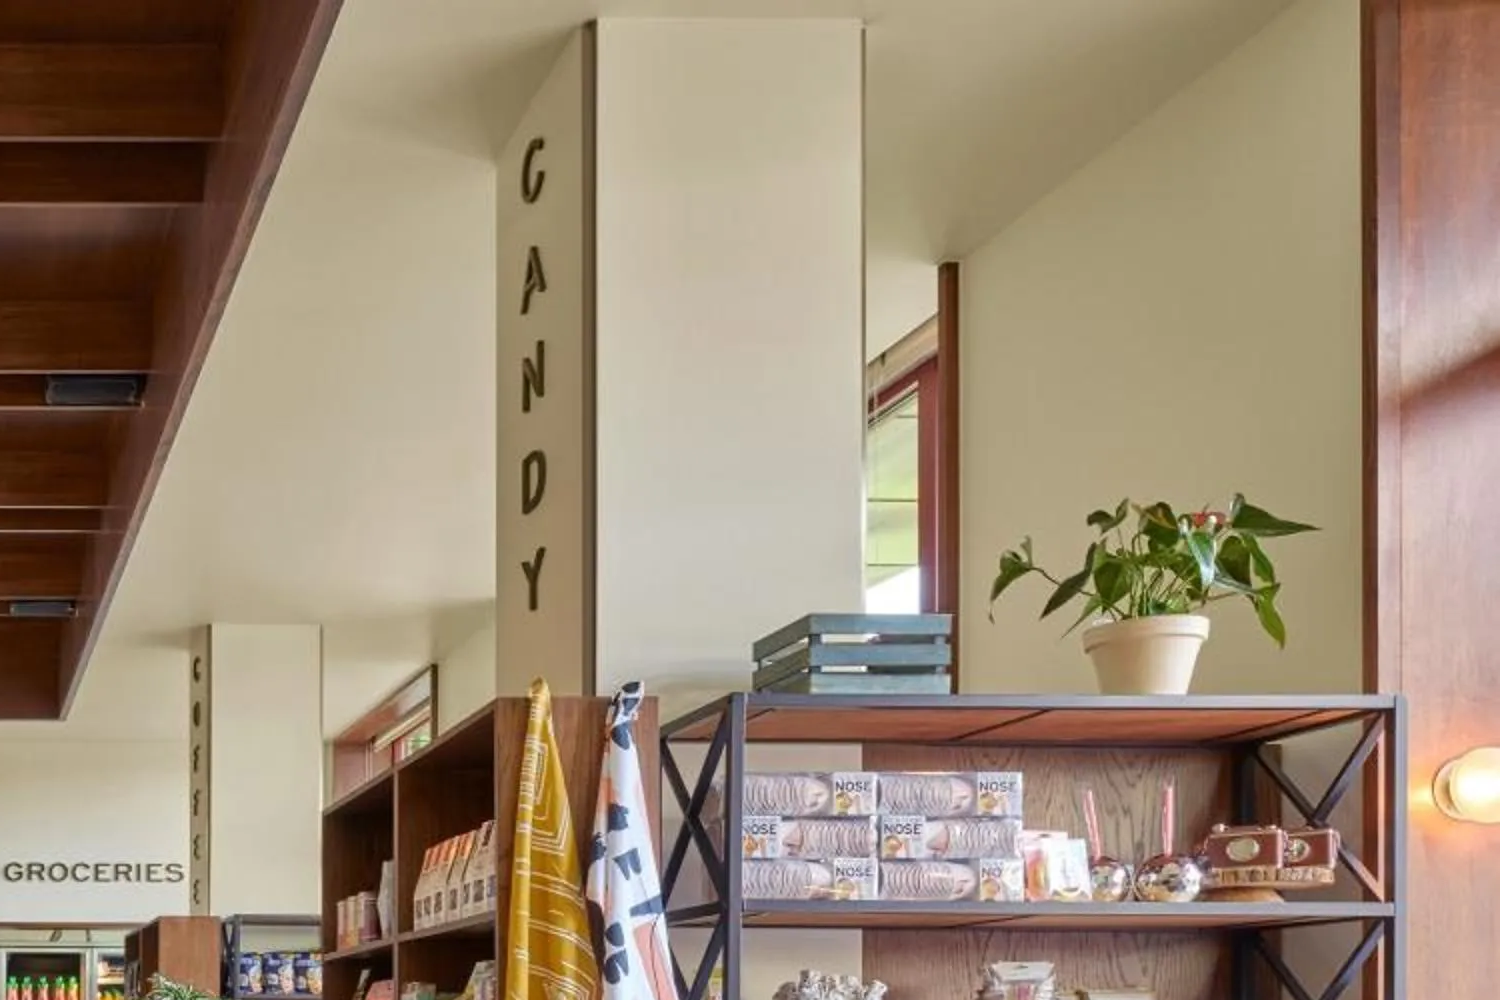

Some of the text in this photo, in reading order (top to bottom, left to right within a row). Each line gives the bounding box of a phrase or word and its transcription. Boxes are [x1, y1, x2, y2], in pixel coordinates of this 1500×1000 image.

[520, 137, 547, 611] CANDY
[835, 781, 873, 793] NOSE
[979, 781, 1017, 793] NOSE
[883, 823, 923, 835] NOSE
[3, 862, 184, 882] GROCERIES
[835, 866, 873, 877] NOSE
